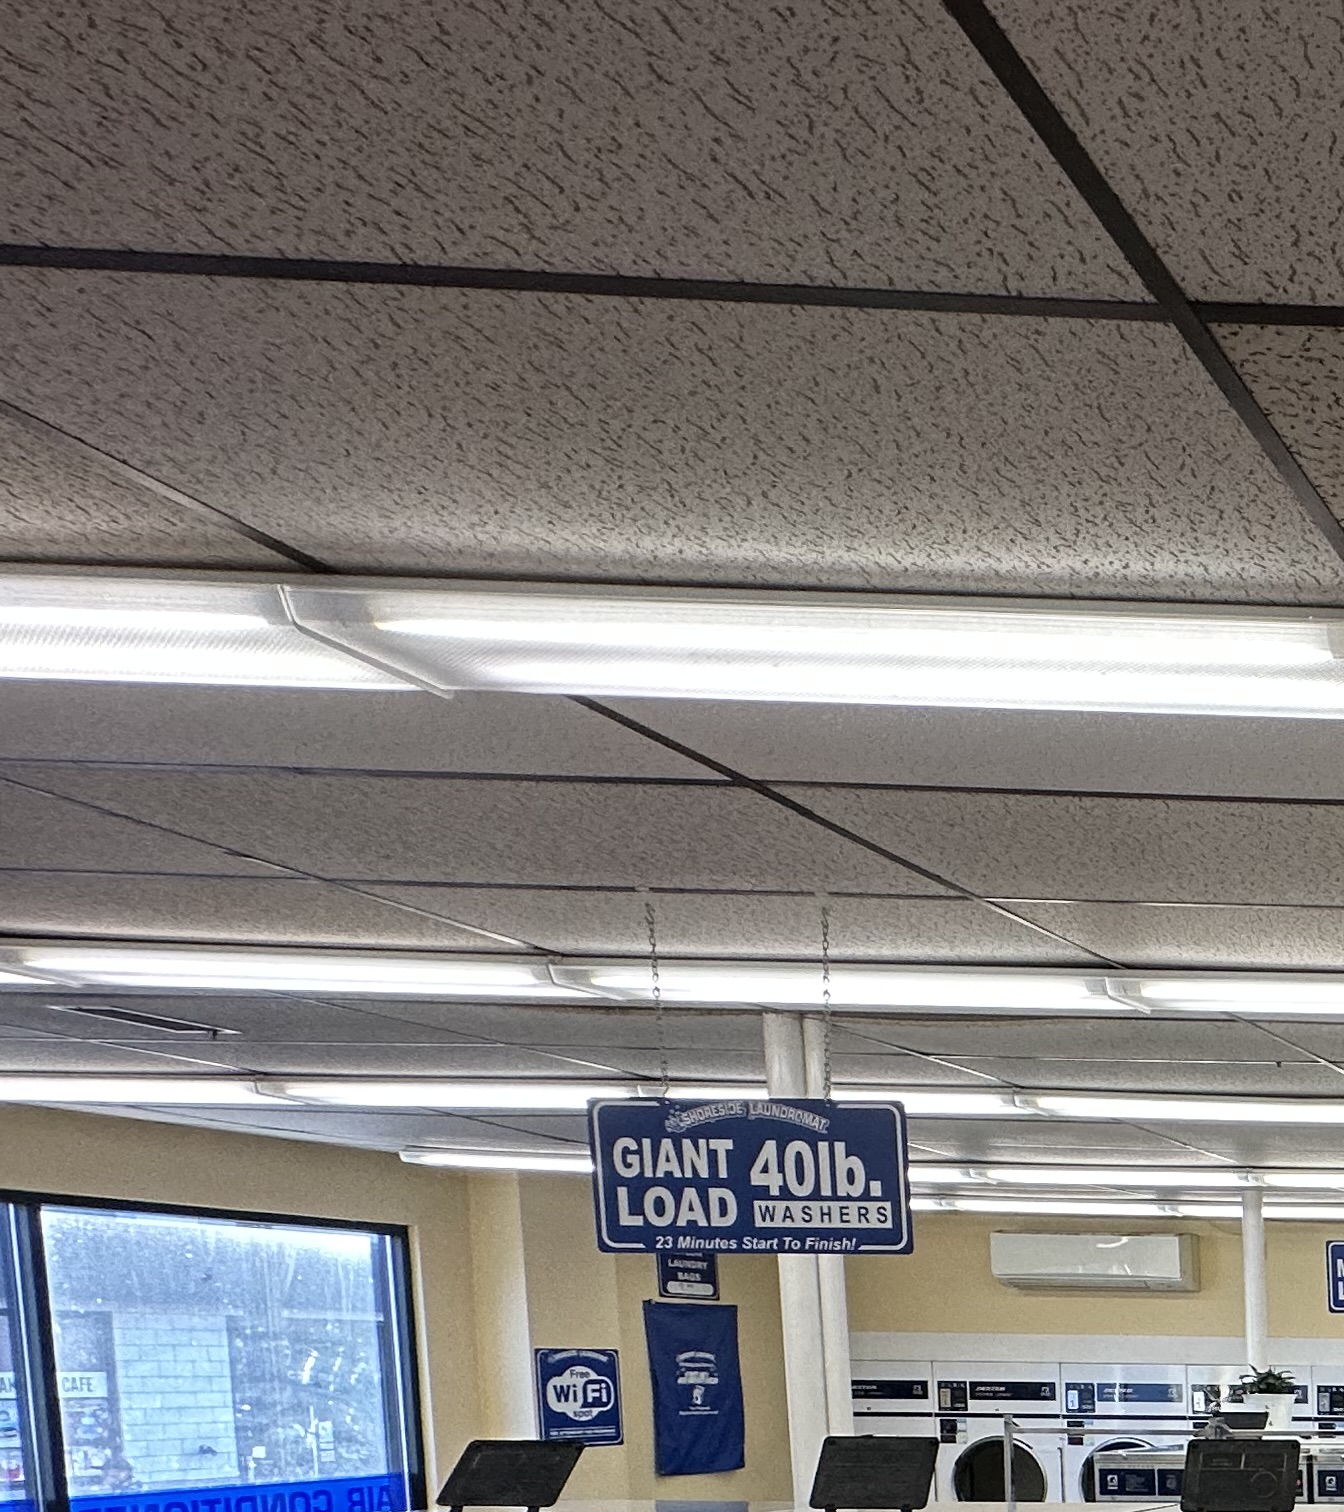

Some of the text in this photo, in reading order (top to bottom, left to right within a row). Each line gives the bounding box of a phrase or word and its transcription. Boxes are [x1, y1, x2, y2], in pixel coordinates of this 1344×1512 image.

[683, 1102, 830, 1133] SHORESIDE LAUNDROMAT
[613, 1137, 882, 1198] GIANT 40lb.
[617, 1186, 889, 1228] LOAD WASHERS
[655, 1236, 857, 1251] 23 Minutes Start To Finish!
[61, 1377, 93, 1392] CAFE
[569, 1370, 591, 1379] Free
